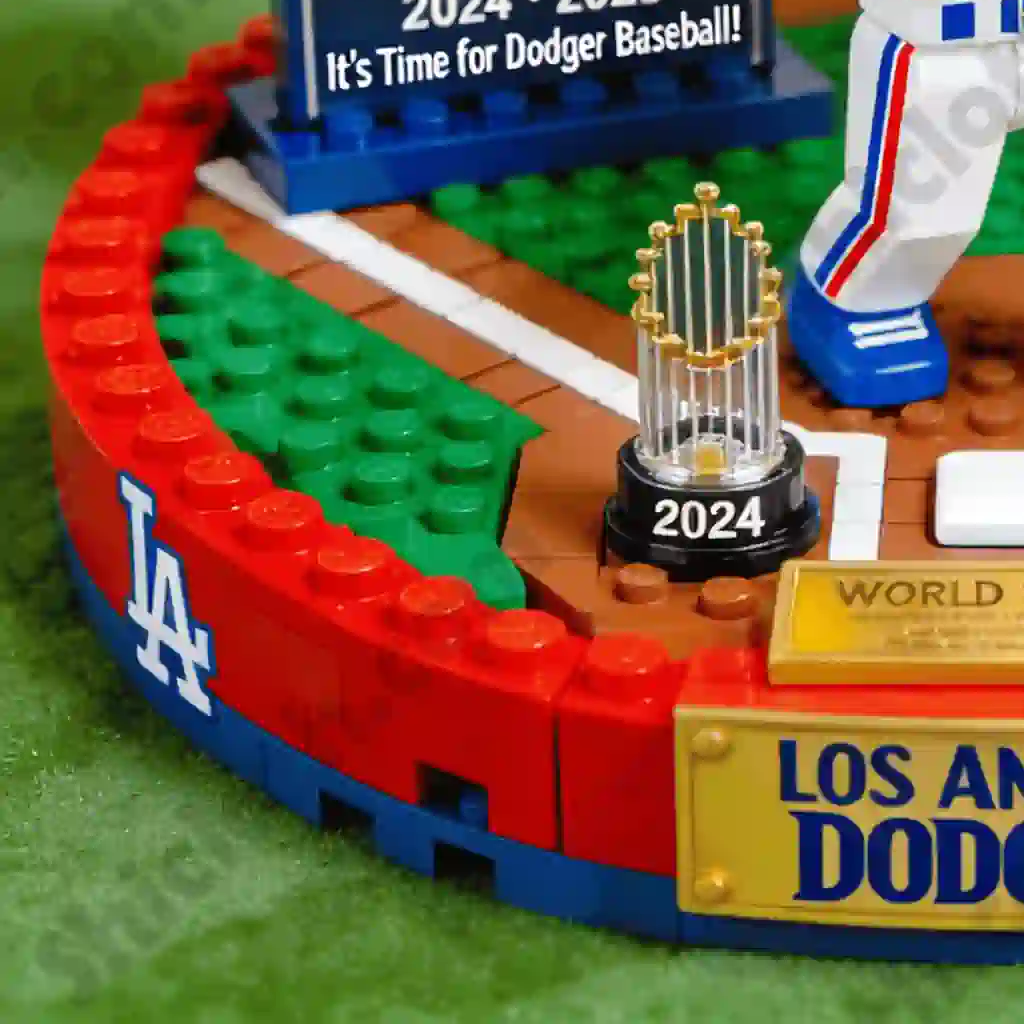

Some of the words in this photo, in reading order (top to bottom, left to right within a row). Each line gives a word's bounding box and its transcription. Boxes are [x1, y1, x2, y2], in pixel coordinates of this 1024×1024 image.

[326, 49, 373, 92] It's
[376, 44, 451, 86] Time
[456, 37, 498, 77] for
[505, 26, 608, 74] Dodger
[614, 4, 742, 57] Baseball!
[652, 496, 766, 540] 2024
[120, 475, 212, 716] LA
[838, 581, 1004, 608] WORLD
[778, 740, 915, 808] LOS
